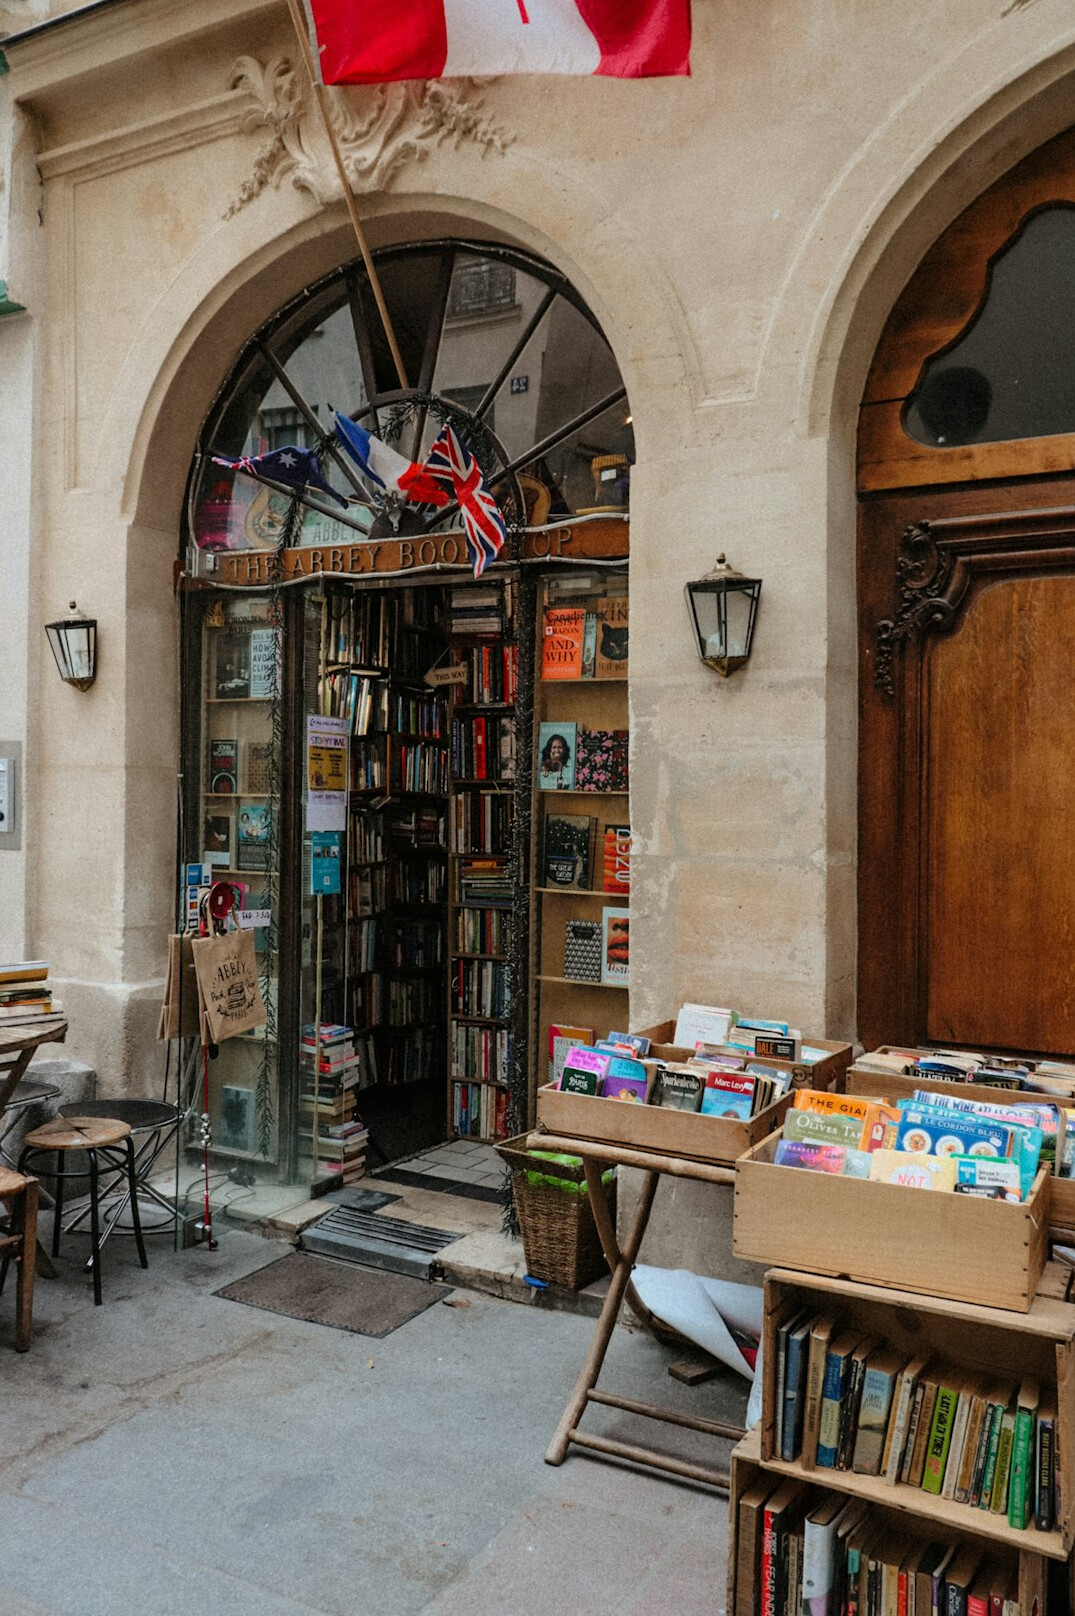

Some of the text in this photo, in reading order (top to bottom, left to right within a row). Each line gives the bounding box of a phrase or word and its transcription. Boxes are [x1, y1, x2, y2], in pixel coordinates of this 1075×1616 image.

[291, 545, 382, 577] ABBEY
[252, 645, 270, 653] HOW
[548, 640, 575, 650] AND
[545, 652, 577, 662] WHY
[435, 671, 466, 681] THIS WAY
[218, 961, 245, 983] ABBEY
[714, 1077, 745, 1092] Marc Levy
[810, 1097, 834, 1108] THE
[933, 1095, 949, 1108] THE
[952, 1100, 975, 1113] WINE
[796, 1114, 838, 1135] OLIVES
[924, 1118, 1003, 1139] LE CORDON BLEU
[938, 1394, 952, 1413] LAST
[930, 1435, 945, 1457] TOWER
[1041, 1447, 1049, 1468] HIGGINS
[1040, 1469, 1048, 1486] CLARK
[764, 1527, 772, 1556] HARRIS
[765, 1564, 776, 1592] FEAR
